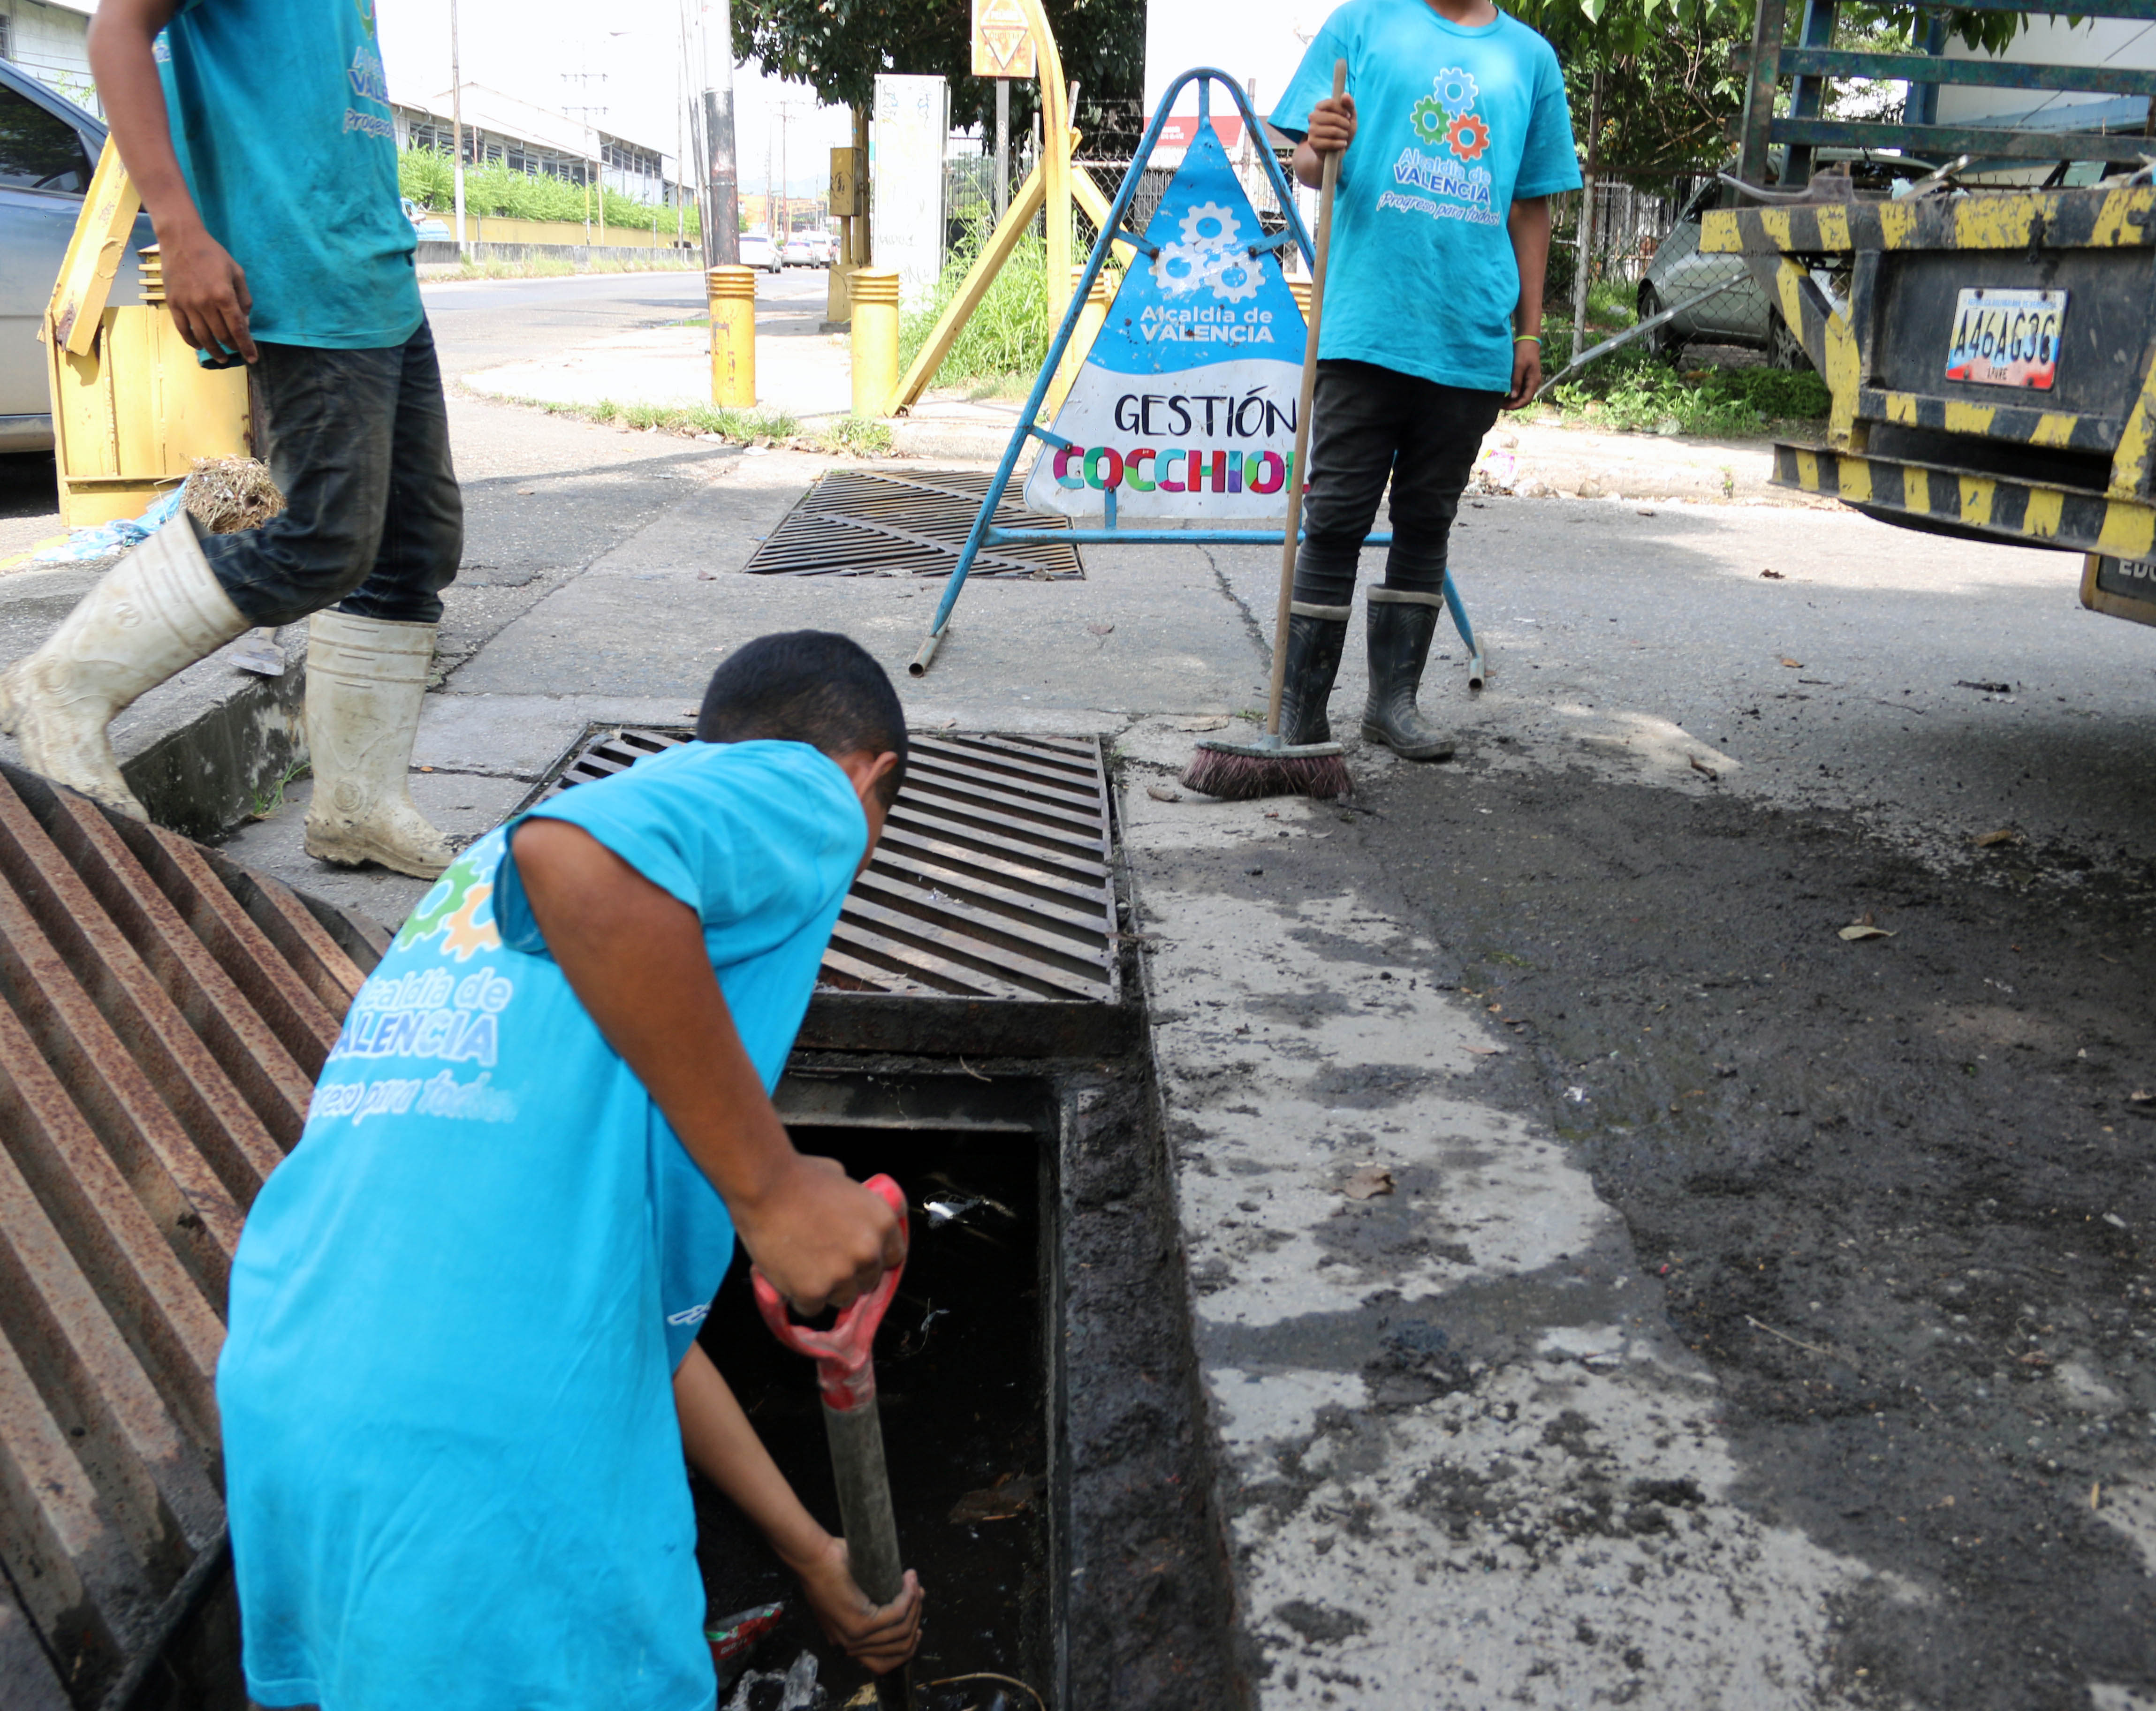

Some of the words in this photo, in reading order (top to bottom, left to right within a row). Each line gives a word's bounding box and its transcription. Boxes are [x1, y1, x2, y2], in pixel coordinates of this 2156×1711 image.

[1394, 163, 1491, 205] VALENCIA
[1398, 147, 1465, 181] Alcaldía
[1468, 166, 1492, 185] de
[1434, 203, 1465, 220] para
[1140, 324, 1275, 342] VALENCIA
[1243, 307, 1273, 323] de
[1115, 385, 1297, 437] GESTIÓN
[1053, 446, 1311, 494] COCCHIOL
[357, 967, 455, 1010] lcaldía
[454, 967, 514, 1012] de
[326, 1008, 497, 1067] ALENCIA
